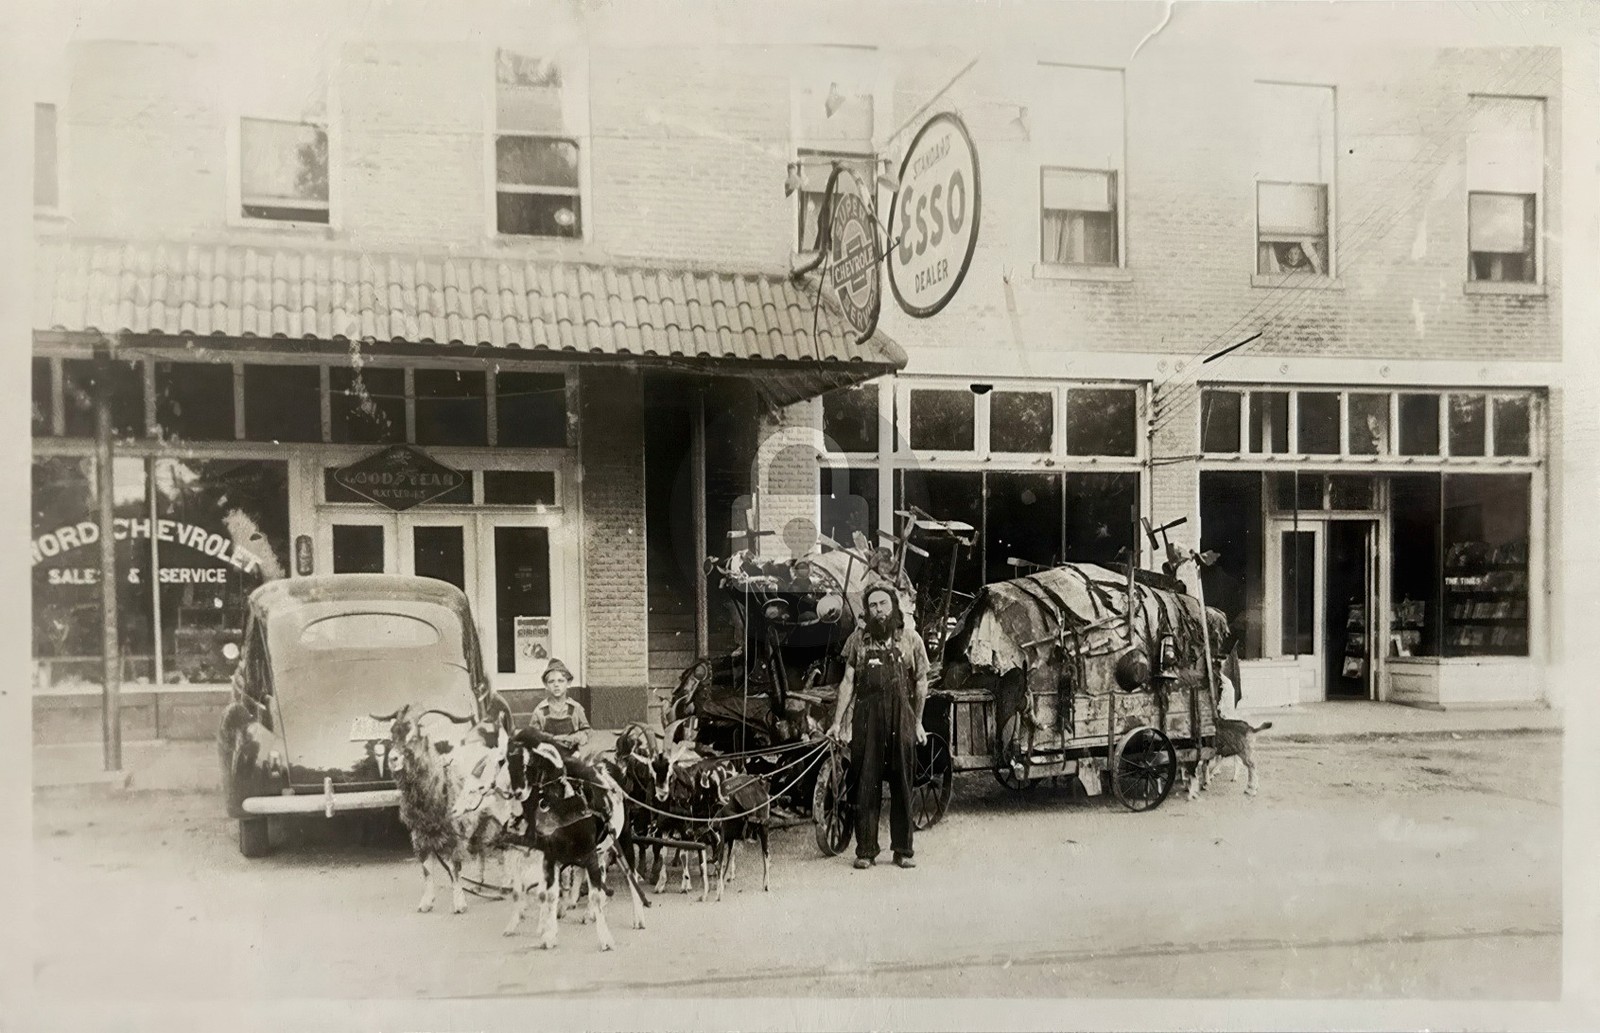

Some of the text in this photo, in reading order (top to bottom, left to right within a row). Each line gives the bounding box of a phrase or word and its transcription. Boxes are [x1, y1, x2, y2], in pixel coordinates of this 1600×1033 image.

[898, 169, 966, 266] ESSO
[834, 245, 875, 284] CHEVROLE
[914, 257, 949, 294] DEALER
[112, 517, 263, 573] CHEVROLET
[48, 567, 227, 584] SALE & SERVICE
